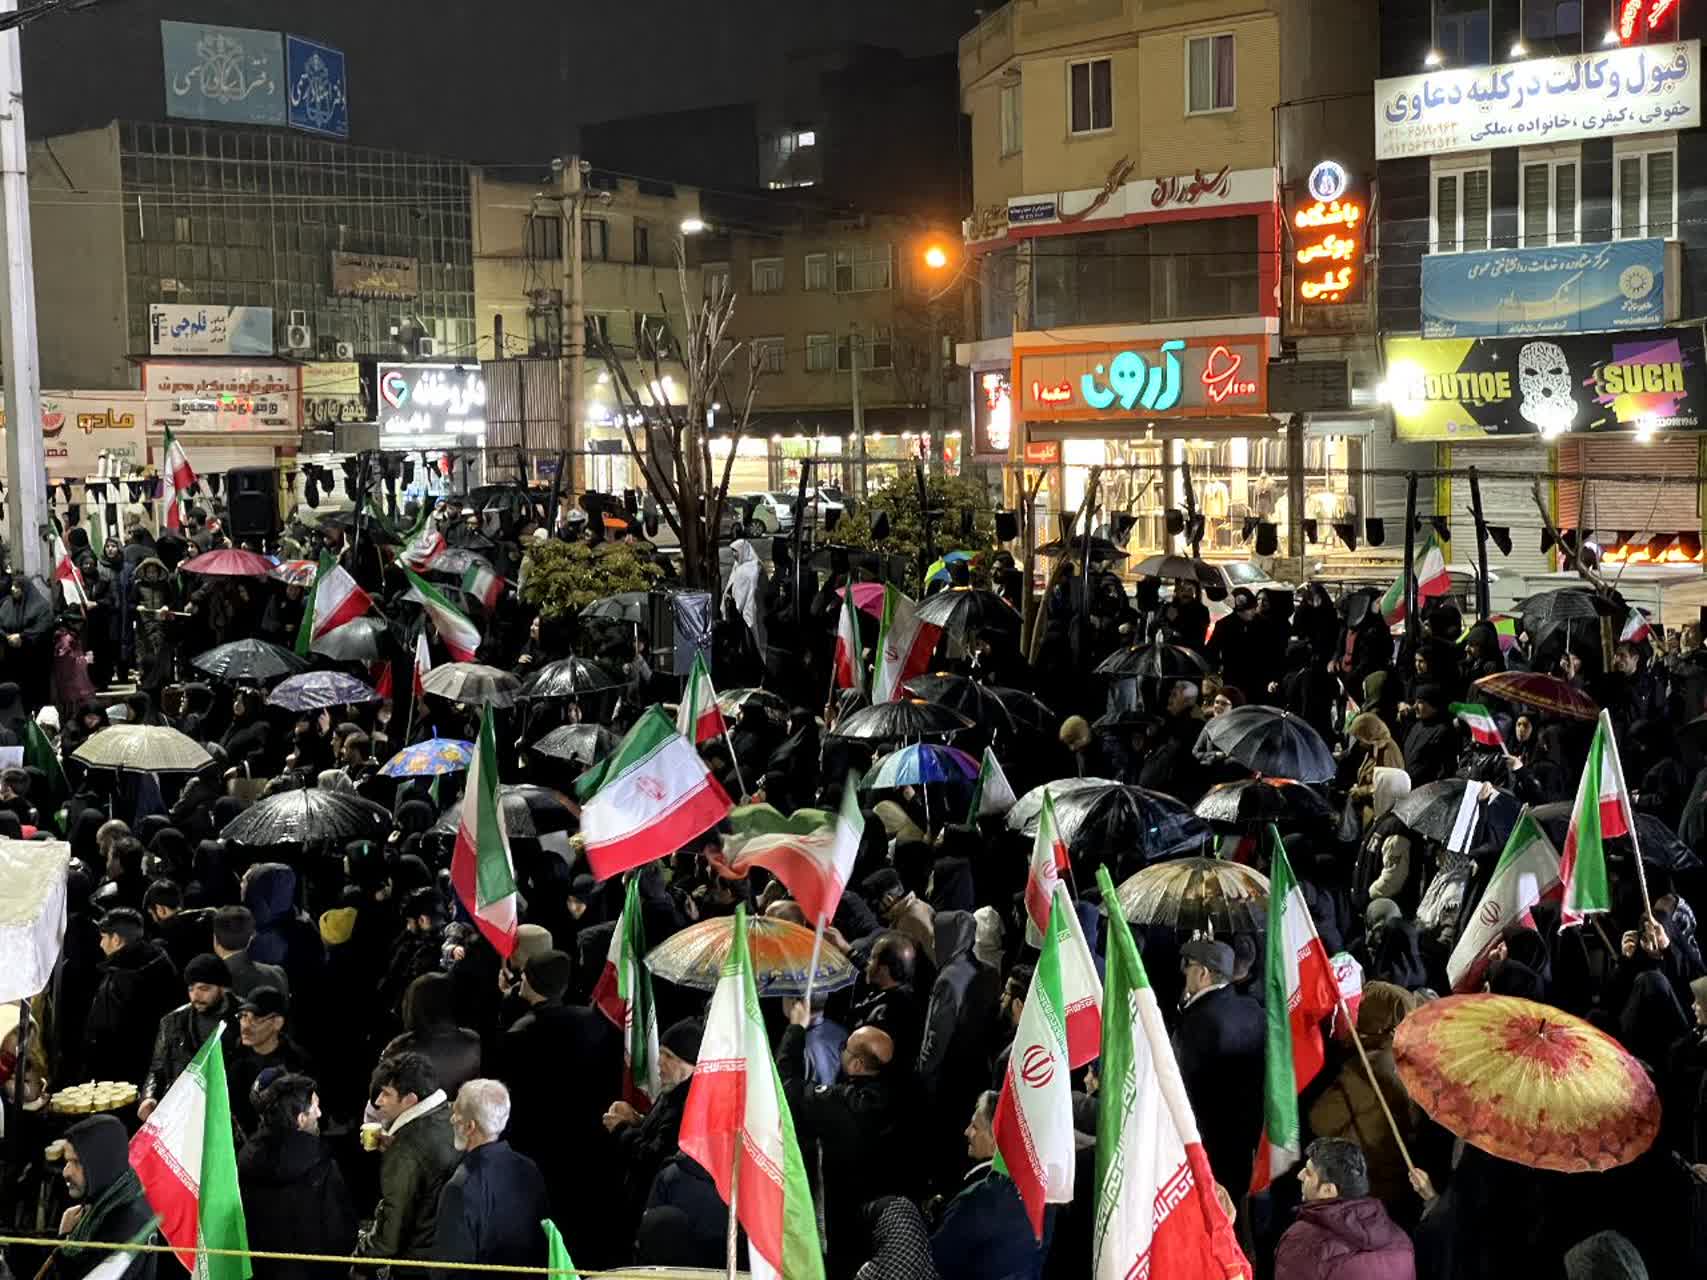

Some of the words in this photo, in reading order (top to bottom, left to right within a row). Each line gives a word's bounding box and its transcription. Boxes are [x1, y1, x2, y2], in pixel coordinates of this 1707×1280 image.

[1547, 58, 1621, 99] وکالت
[1626, 46, 1689, 94] قبول
[1385, 81, 1462, 122] دعاوی
[1081, 340, 1186, 411] آرون
[1409, 371, 1512, 402] OUTIQE
[1604, 361, 1685, 395] SUCH
